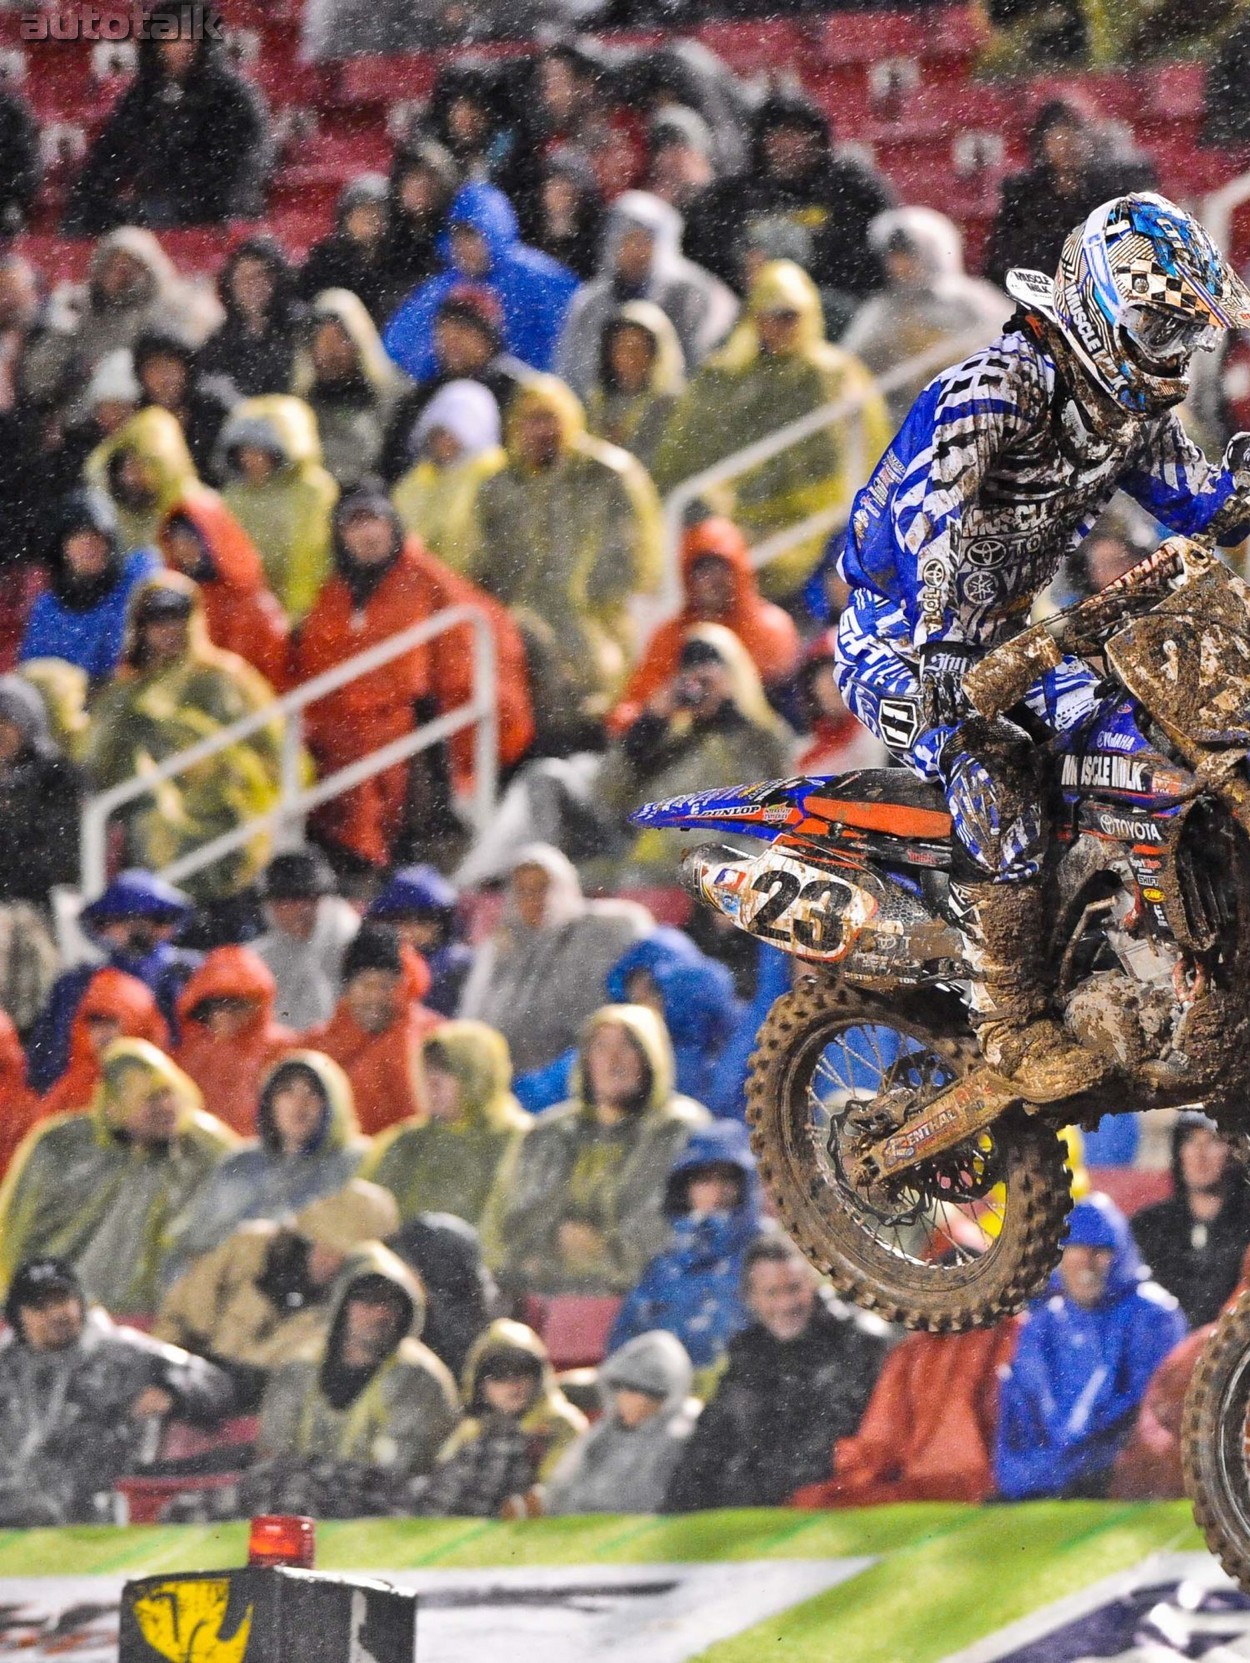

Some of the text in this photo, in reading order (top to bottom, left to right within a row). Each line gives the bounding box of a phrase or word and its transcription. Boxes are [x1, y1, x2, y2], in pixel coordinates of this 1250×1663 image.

[1012, 270, 1052, 286] MUSCLE
[1064, 283, 1103, 354] MUSCLE
[962, 502, 1050, 539] MUSCL
[1111, 755, 1148, 792] MILK
[702, 806, 760, 817] DUNLOP
[1114, 818, 1162, 841] TOYOTA
[748, 870, 853, 951] 23
